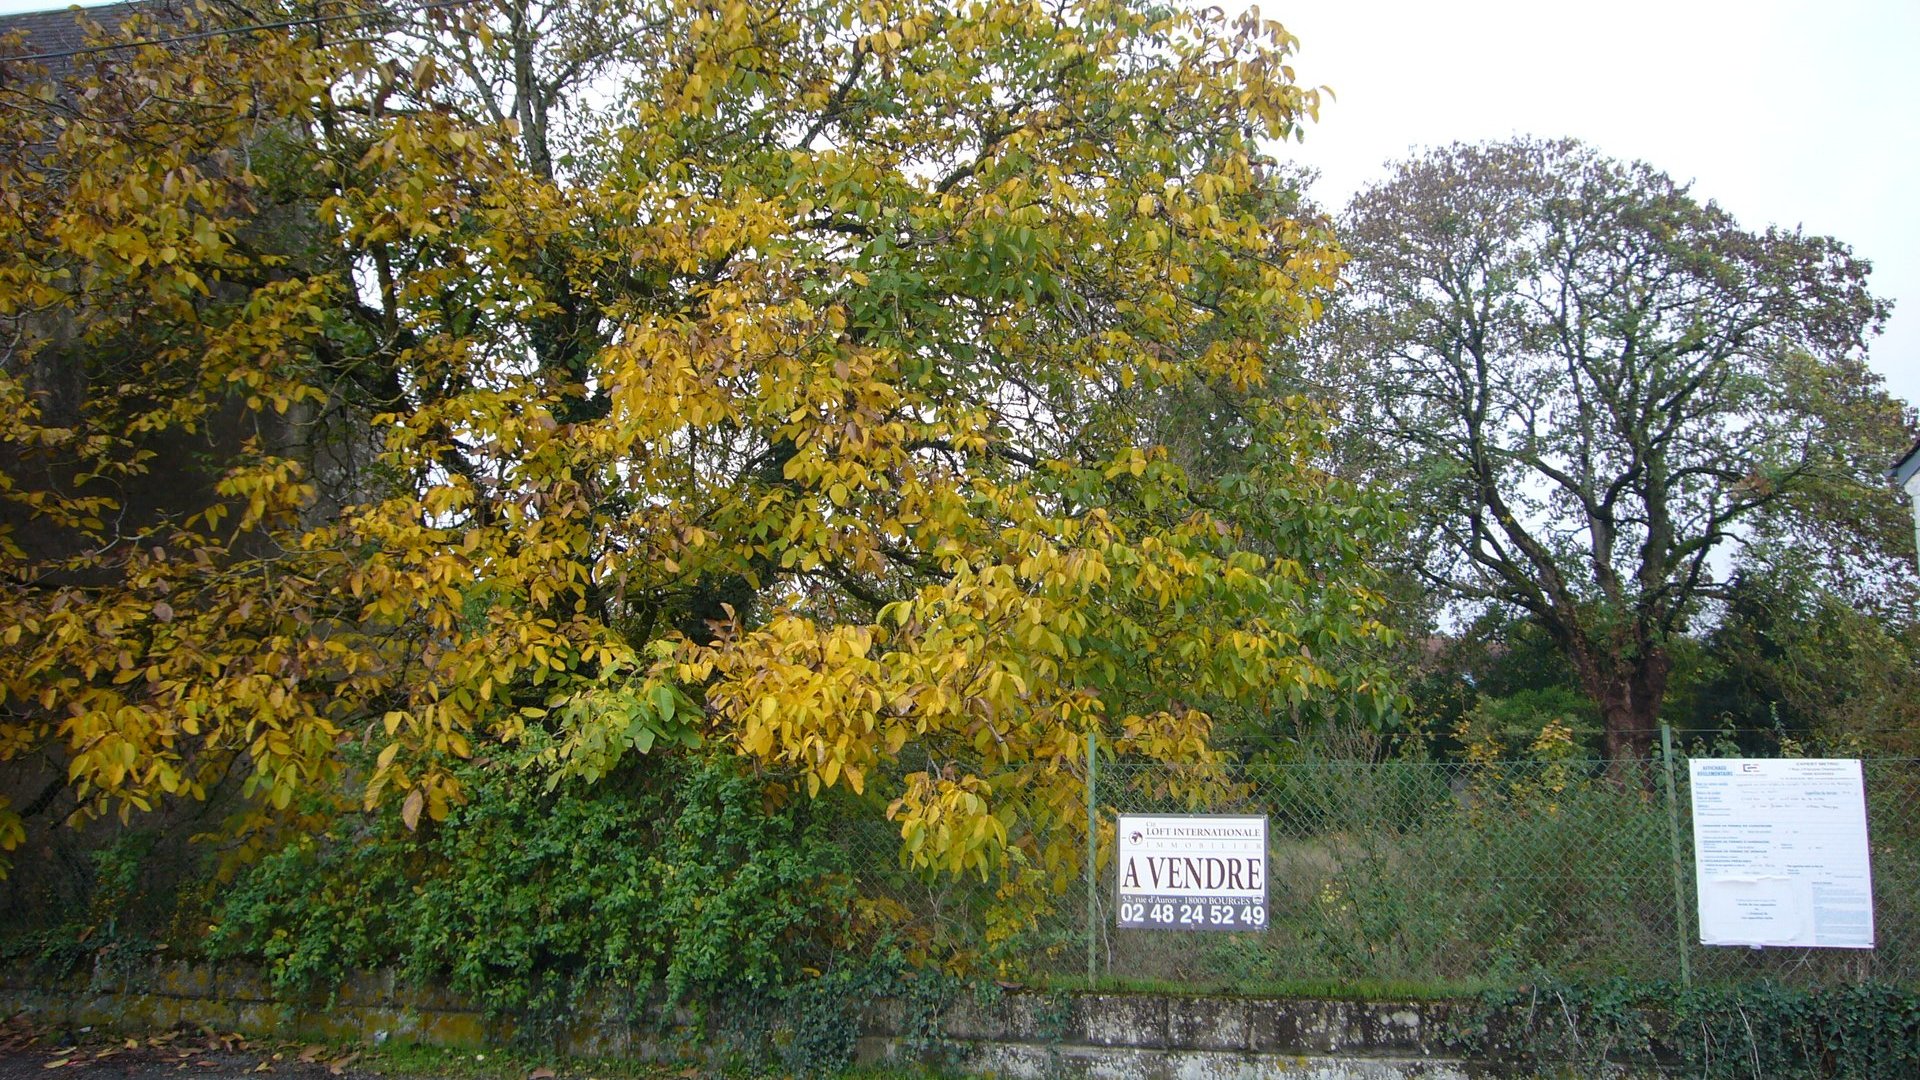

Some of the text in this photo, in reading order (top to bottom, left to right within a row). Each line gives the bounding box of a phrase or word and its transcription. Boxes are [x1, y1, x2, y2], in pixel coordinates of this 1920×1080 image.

[1146, 828, 1261, 837] LOFT INTERNATIONALE
[1122, 856, 1262, 890] A VENDRE
[1148, 896, 1177, 904] d'Auron
[1184, 896, 1206, 905] 18000
[1209, 897, 1250, 905] BOURGES
[1120, 903, 1265, 925] 02 48 24 52 49
